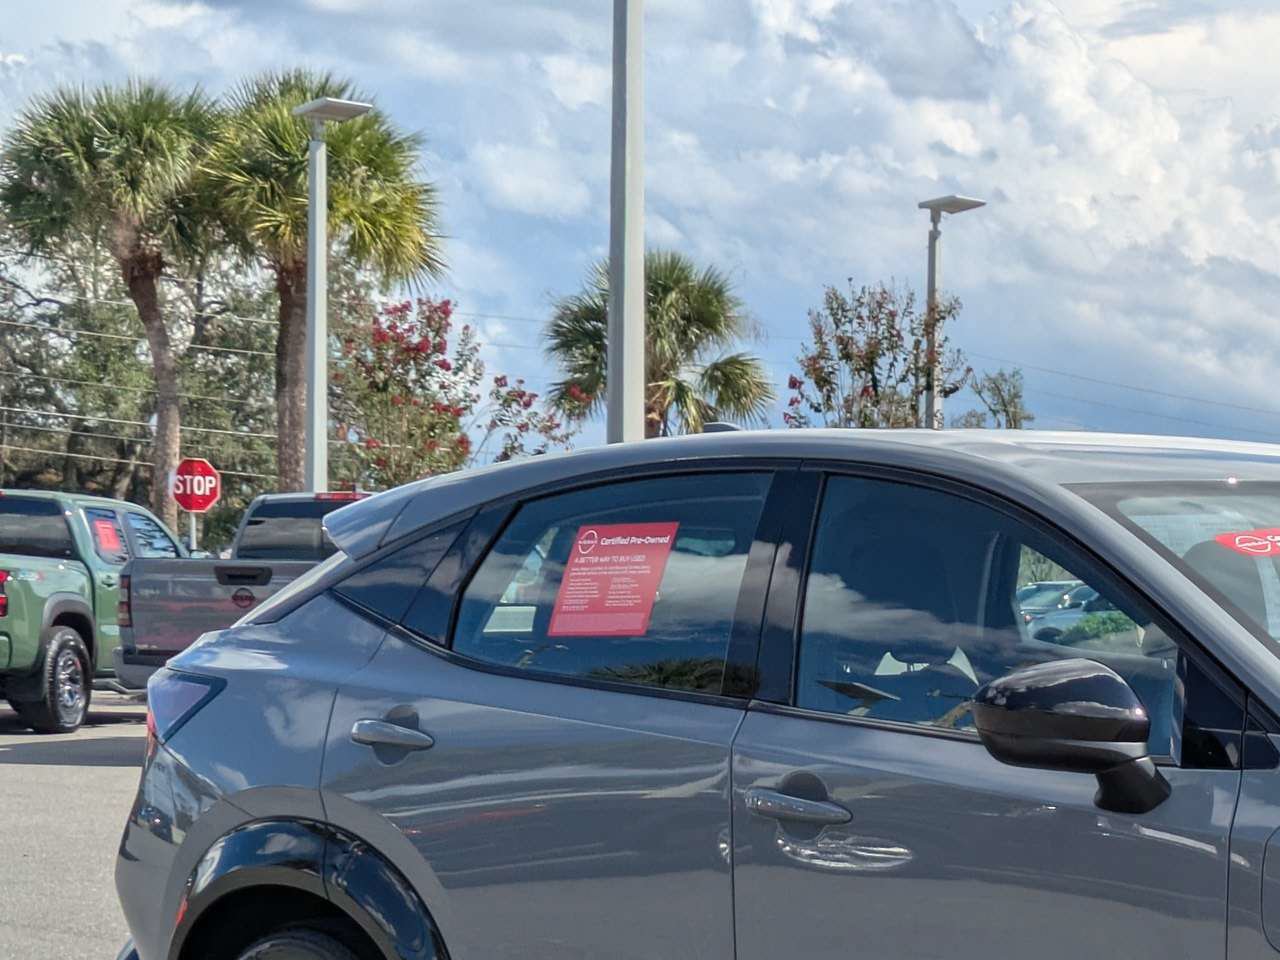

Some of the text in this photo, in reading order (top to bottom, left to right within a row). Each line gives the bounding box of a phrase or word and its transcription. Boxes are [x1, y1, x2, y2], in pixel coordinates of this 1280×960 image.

[174, 475, 217, 496] STOP
[600, 537, 631, 546] Certified
[629, 535, 671, 544] Pre-Owned
